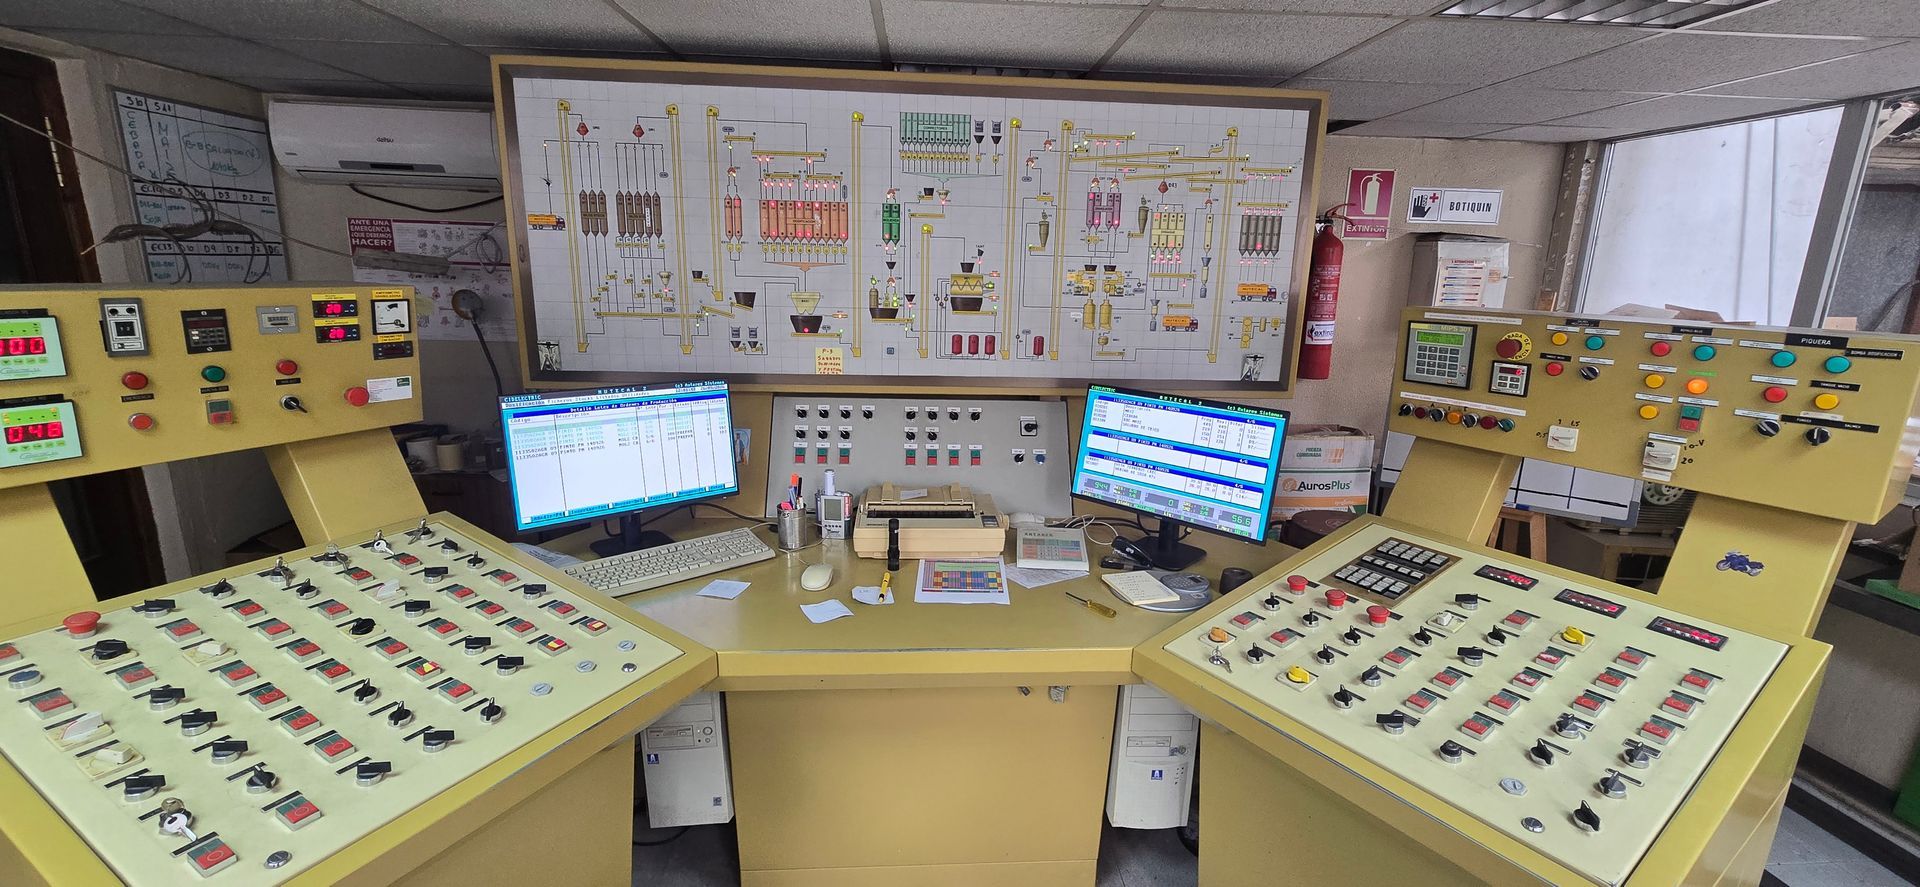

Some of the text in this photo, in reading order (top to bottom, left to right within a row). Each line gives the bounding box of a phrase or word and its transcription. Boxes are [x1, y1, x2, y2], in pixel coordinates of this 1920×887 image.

[218, 191, 231, 200] D3
[242, 194, 255, 202] D2
[1449, 201, 1492, 213] BOTIQUIN
[351, 238, 393, 247] HACER?
[1801, 337, 1832, 346] PIQUERA
[1297, 480, 1352, 492] AurosPlus
